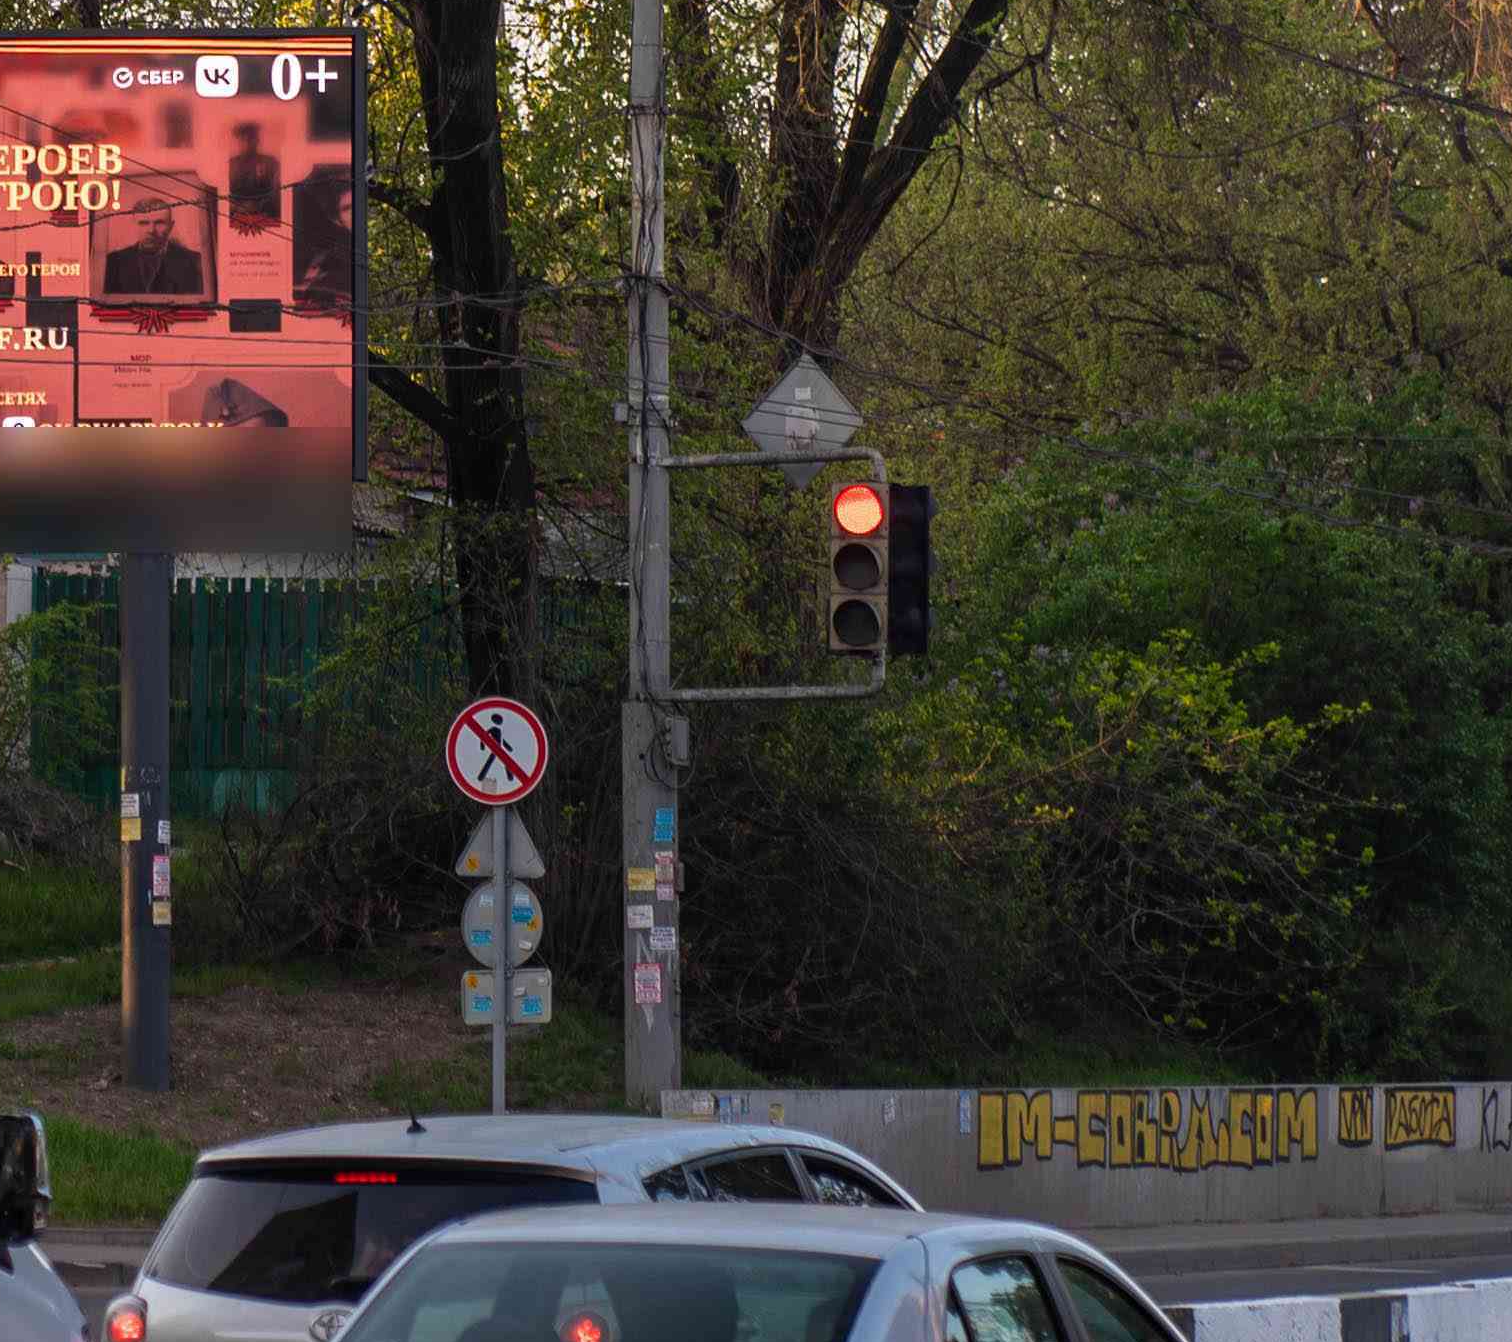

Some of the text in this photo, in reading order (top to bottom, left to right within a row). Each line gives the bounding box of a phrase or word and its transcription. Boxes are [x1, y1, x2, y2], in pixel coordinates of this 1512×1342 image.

[137, 70, 184, 84] СБЕР
[271, 53, 338, 100] 0+
[31, 263, 81, 276] ГЕРОЯ
